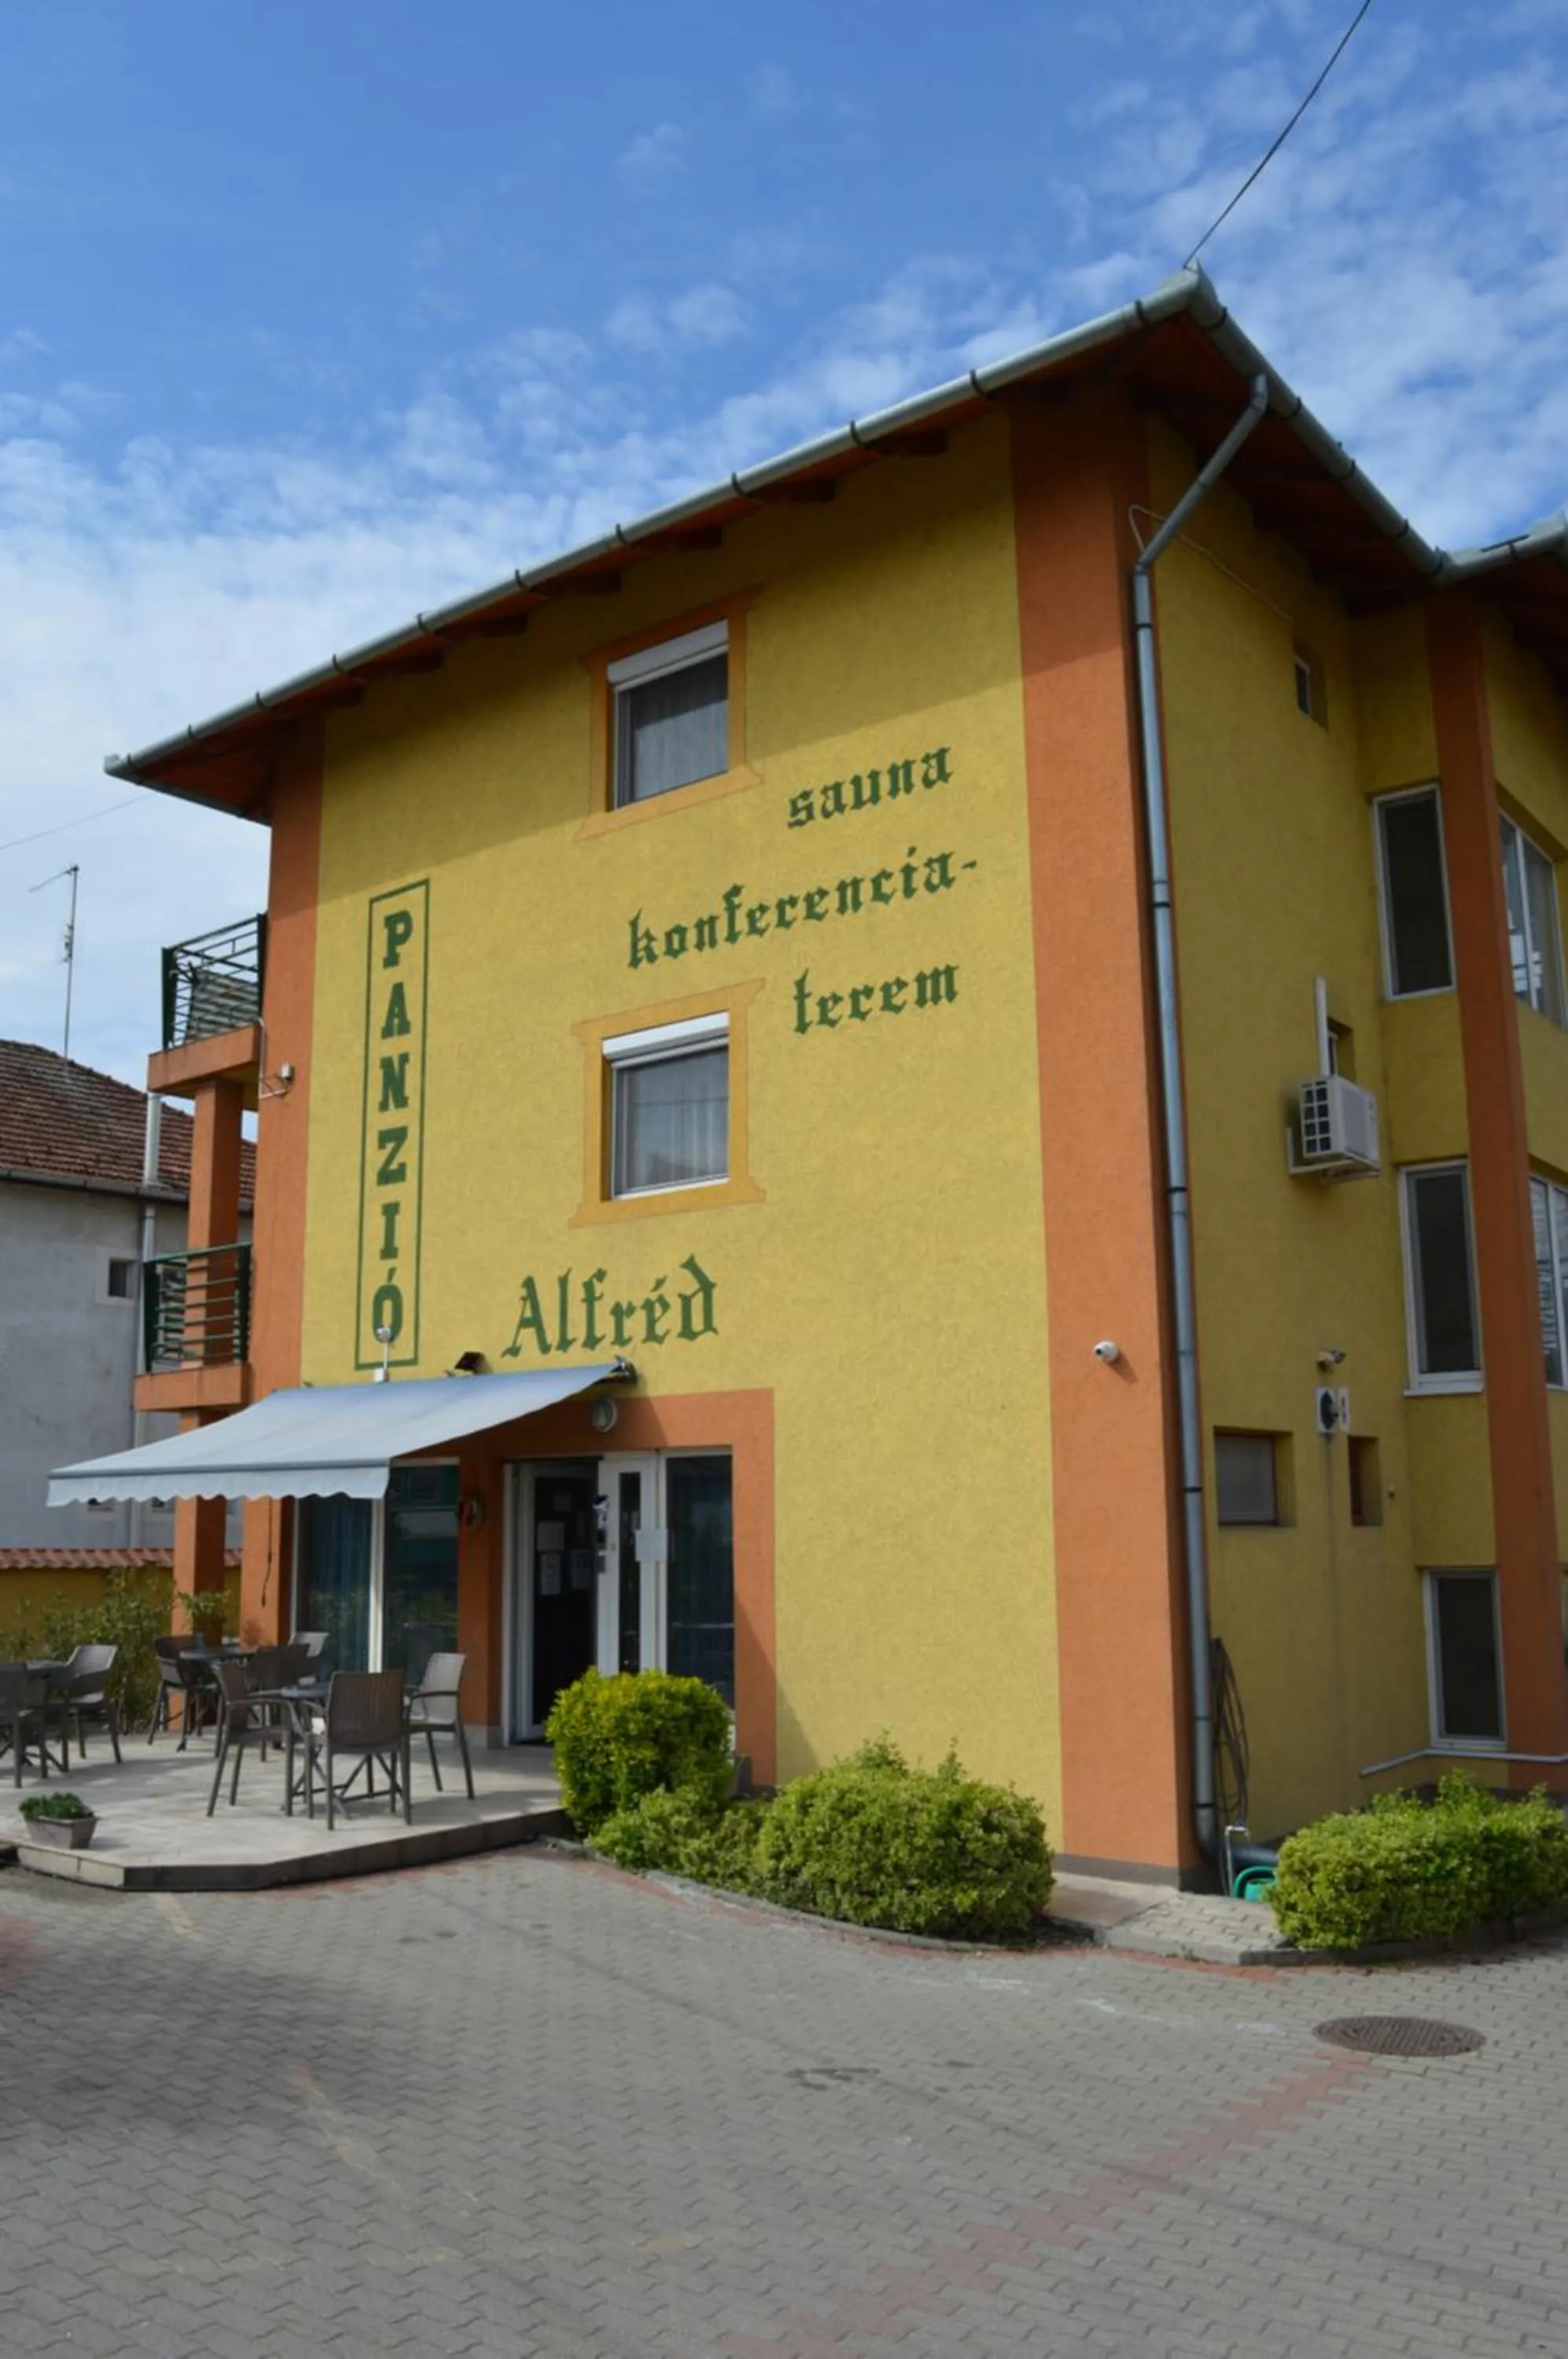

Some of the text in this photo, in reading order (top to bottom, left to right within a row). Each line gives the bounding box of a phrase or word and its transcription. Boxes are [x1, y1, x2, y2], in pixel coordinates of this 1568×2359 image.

[787, 746, 953, 829] sauna
[793, 966, 959, 1035] terem
[372, 909, 414, 1345] PANZIÓ
[501, 1253, 719, 1358] Alfréd
